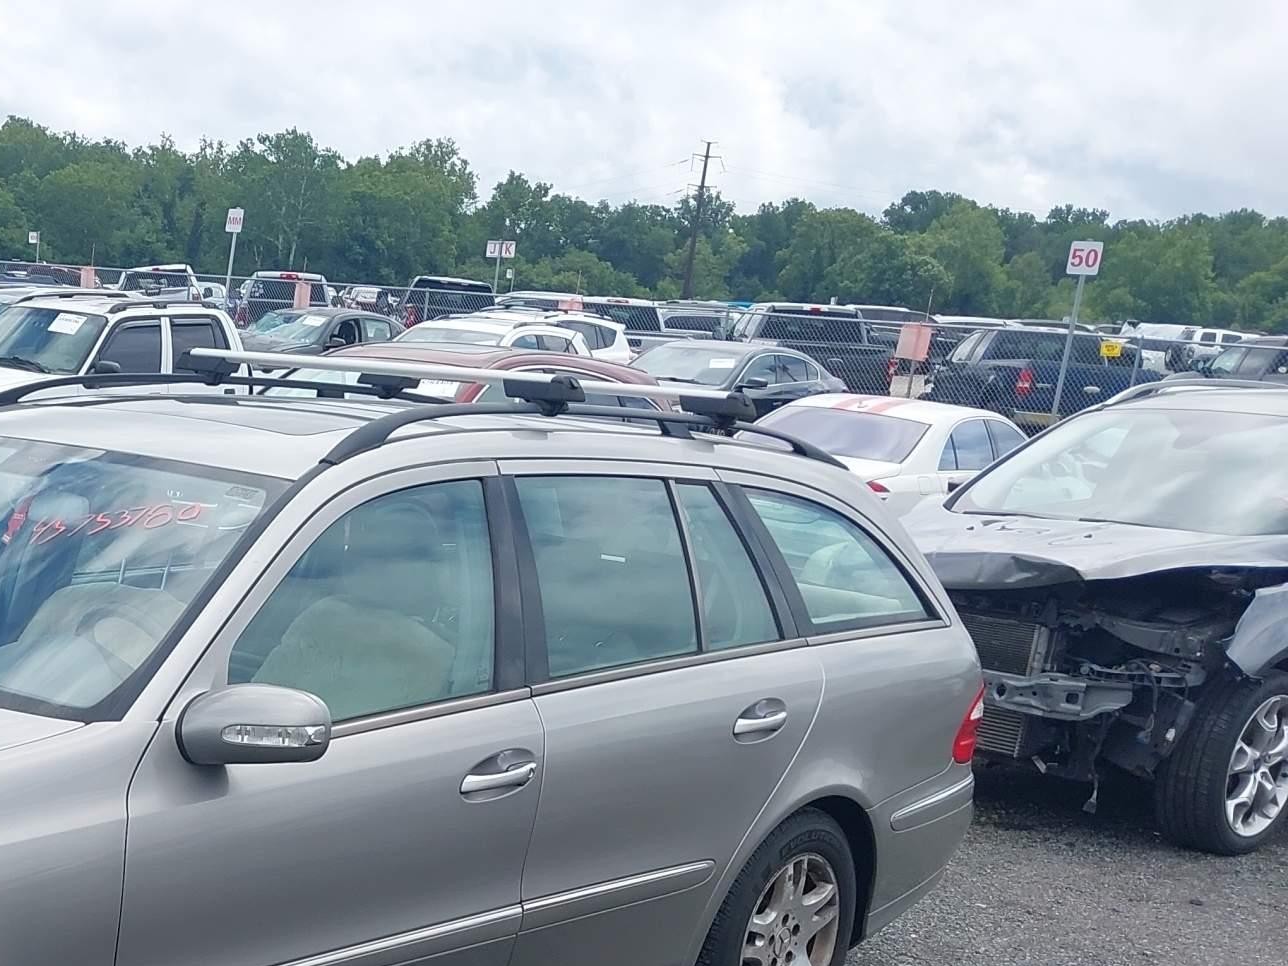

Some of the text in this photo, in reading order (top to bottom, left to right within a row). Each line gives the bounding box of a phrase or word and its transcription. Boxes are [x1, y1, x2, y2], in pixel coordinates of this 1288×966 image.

[489, 243, 497, 255] J
[504, 243, 514, 255] K
[1070, 248, 1099, 268] 50
